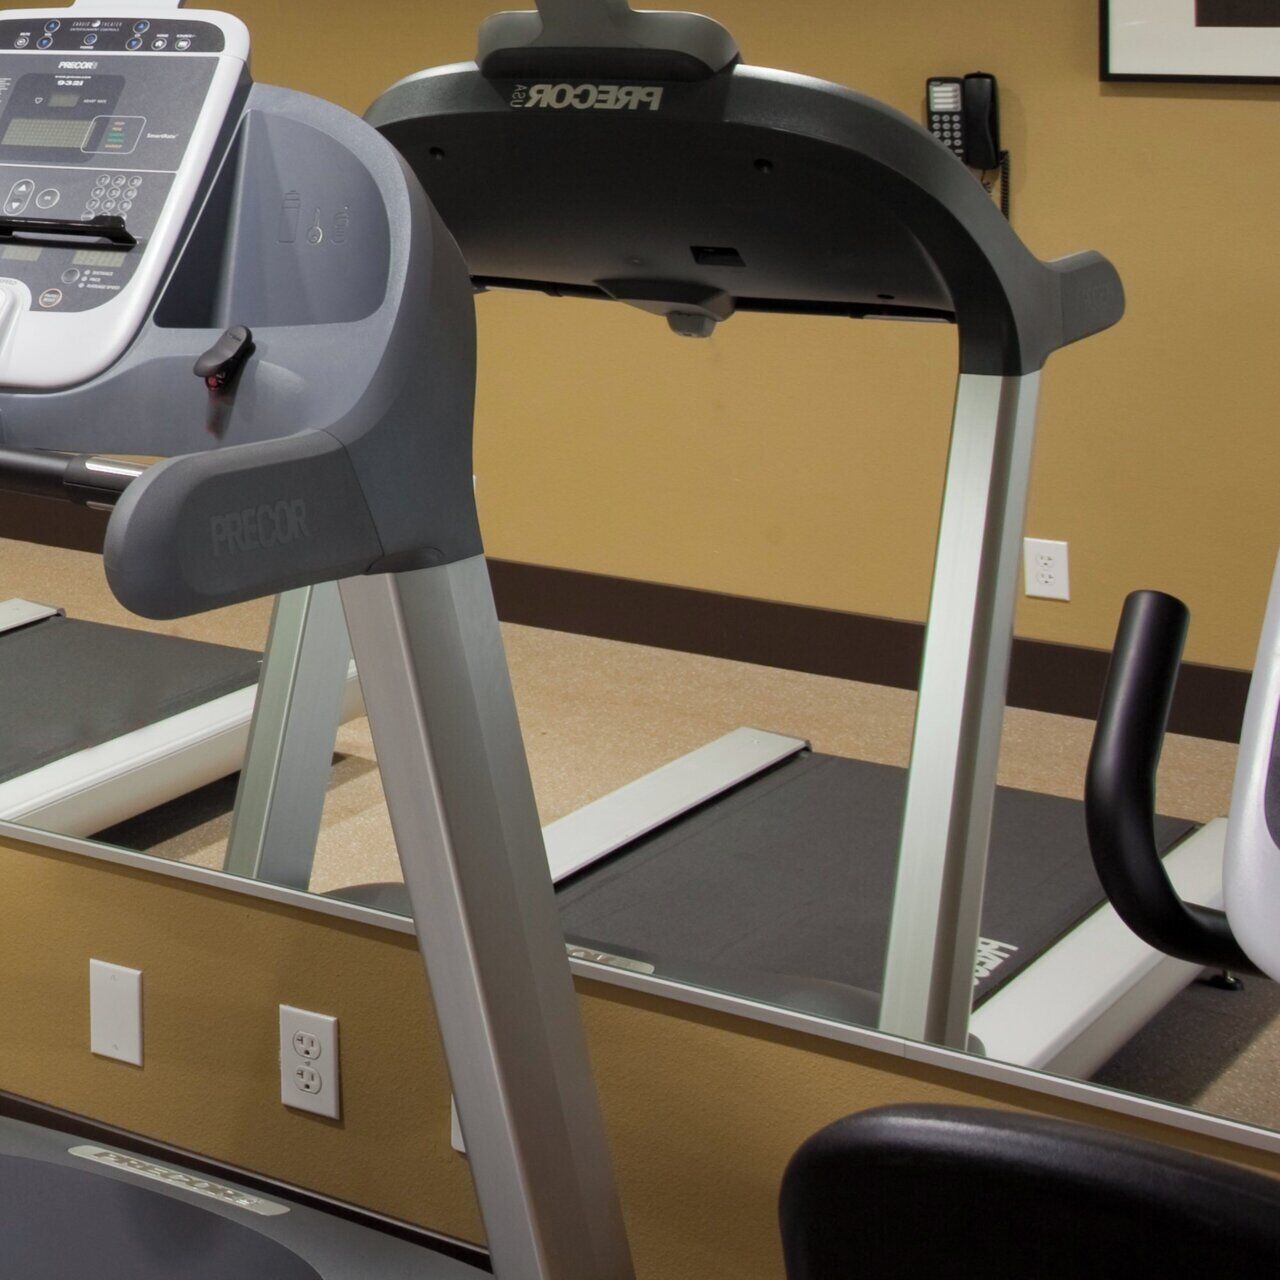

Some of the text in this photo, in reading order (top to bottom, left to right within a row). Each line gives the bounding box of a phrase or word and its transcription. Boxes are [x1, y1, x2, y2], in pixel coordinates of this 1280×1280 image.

[58, 61, 94, 69] PRECOR
[209, 498, 310, 558] PRECOR
[92, 1151, 245, 1203] PRECOR
